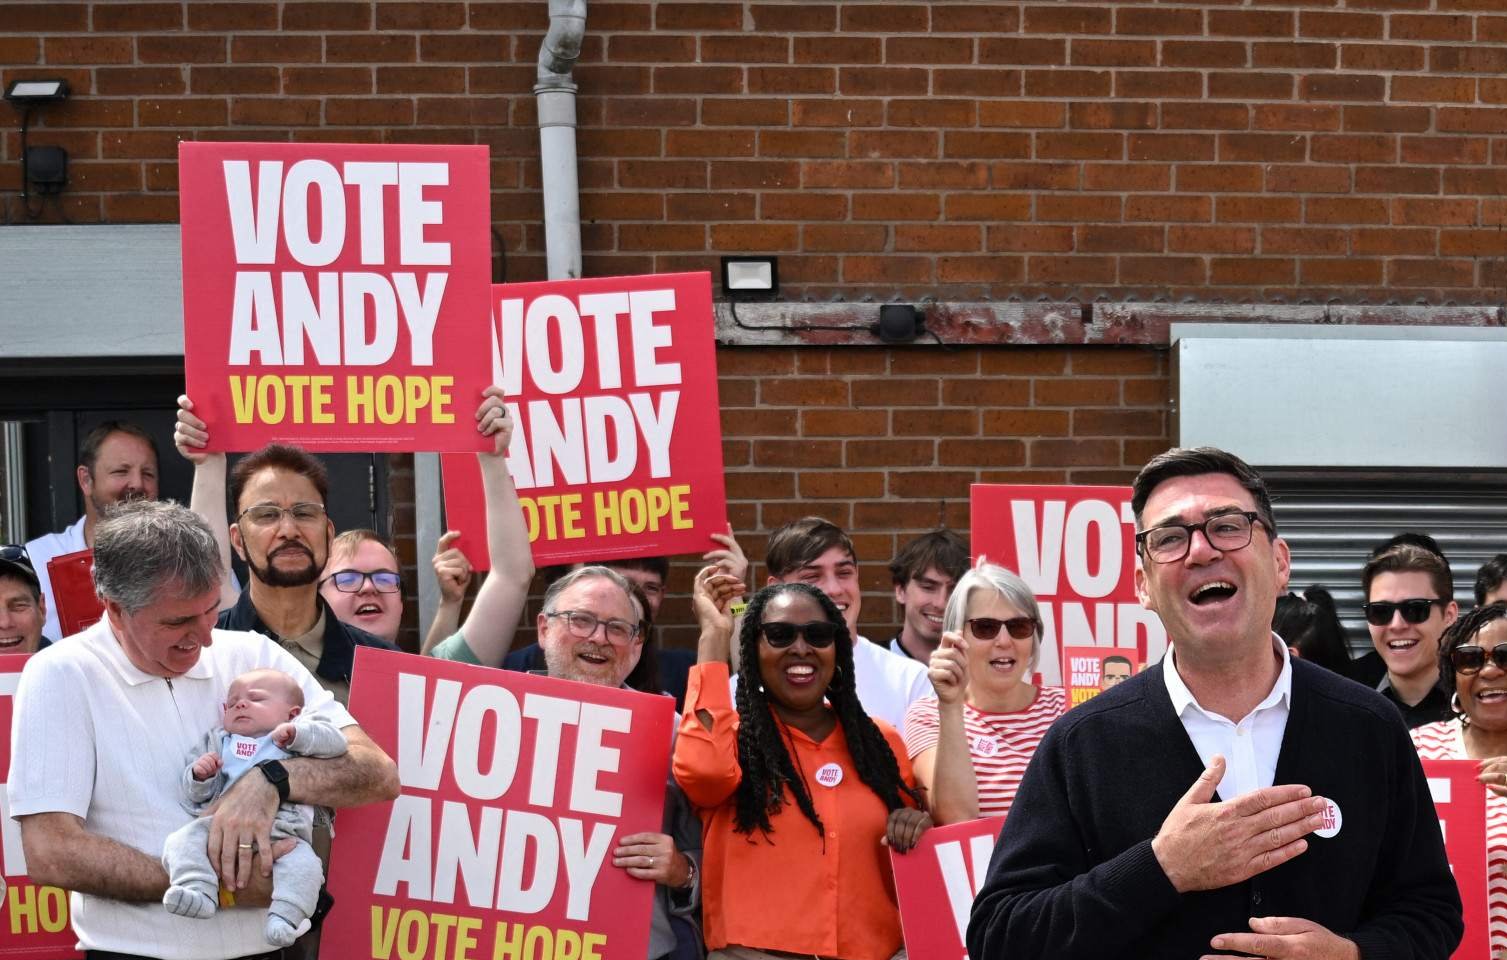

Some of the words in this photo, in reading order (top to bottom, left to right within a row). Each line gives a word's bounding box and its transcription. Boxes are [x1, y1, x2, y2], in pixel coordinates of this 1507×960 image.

[223, 159, 452, 266] VOTE
[228, 271, 450, 367] ANDY
[492, 289, 682, 397] VOTE
[230, 375, 334, 424] VOTE
[348, 375, 455, 424] HOPE
[518, 493, 586, 543] OTE
[594, 485, 693, 537] HOPE
[1010, 499, 1137, 598] VO
[1071, 657, 1100, 672] VOTE
[1071, 673, 1100, 686] ANDY
[237, 742, 257, 751] VOTE
[398, 672, 633, 818] VOTE
[373, 795, 617, 921] ANDY
[8, 885, 69, 934] HO
